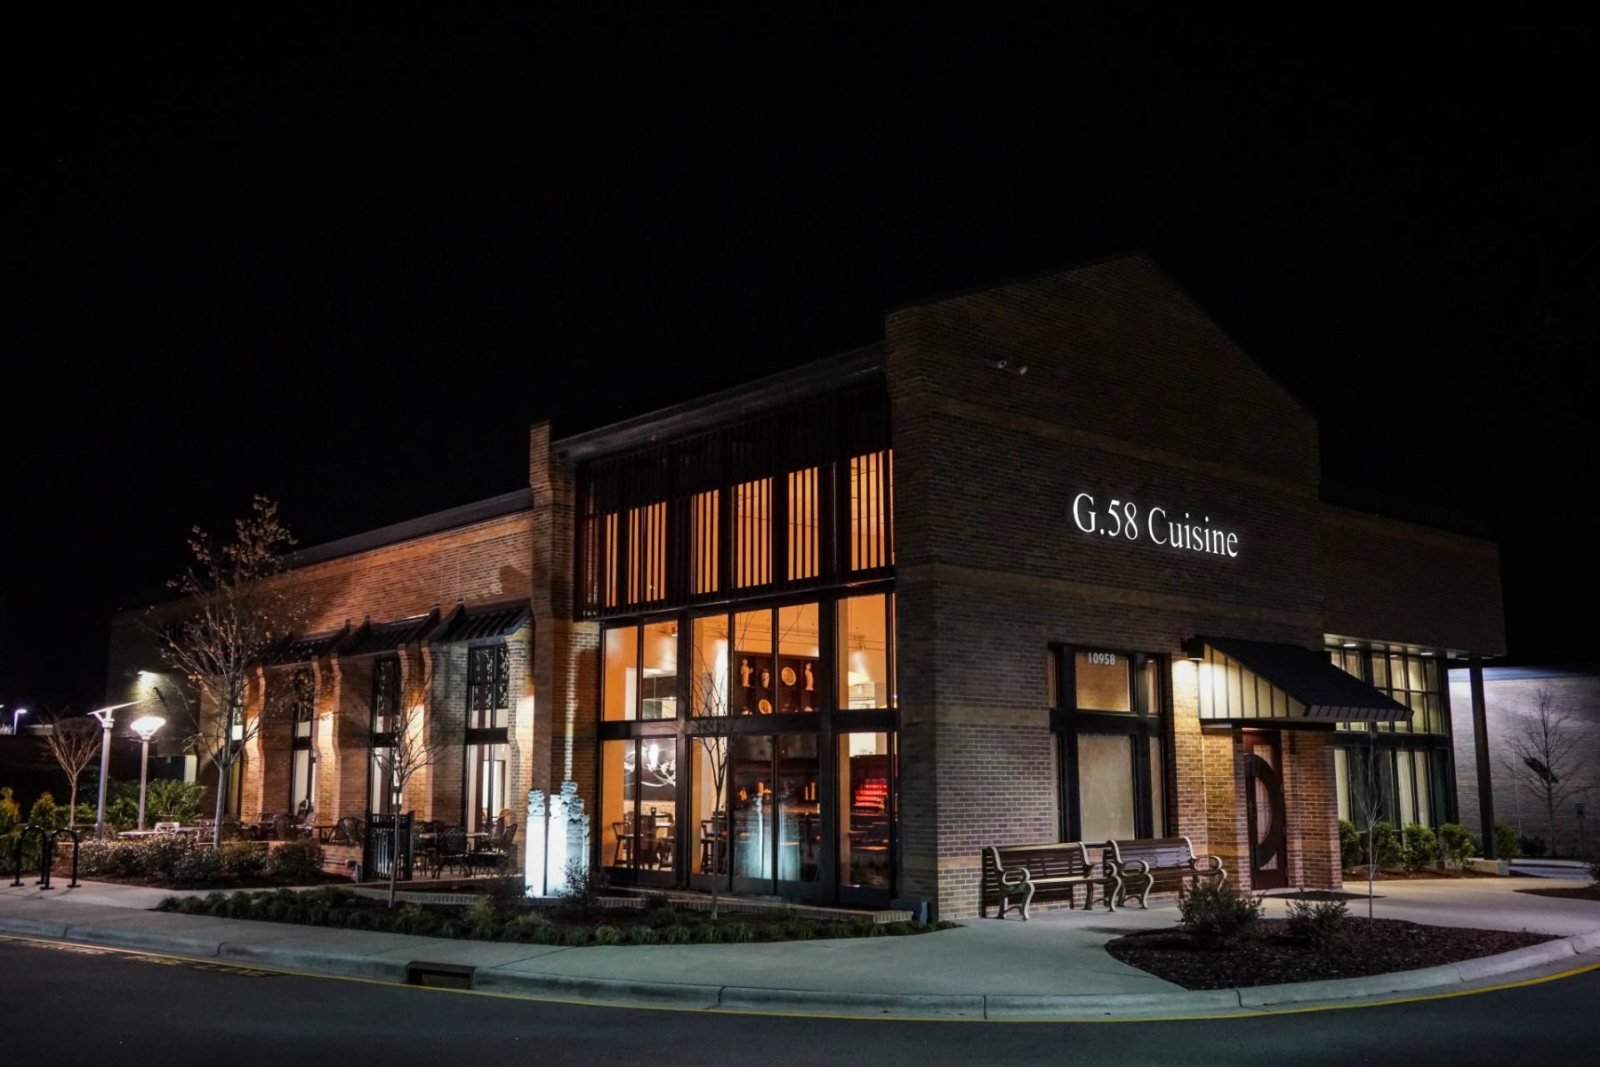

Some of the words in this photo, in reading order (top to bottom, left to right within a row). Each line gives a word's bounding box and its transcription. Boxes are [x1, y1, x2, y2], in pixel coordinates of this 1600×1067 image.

[1073, 493, 1138, 540] G.58
[1148, 507, 1239, 557] Cuisine
[1088, 652, 1116, 665] 10958
